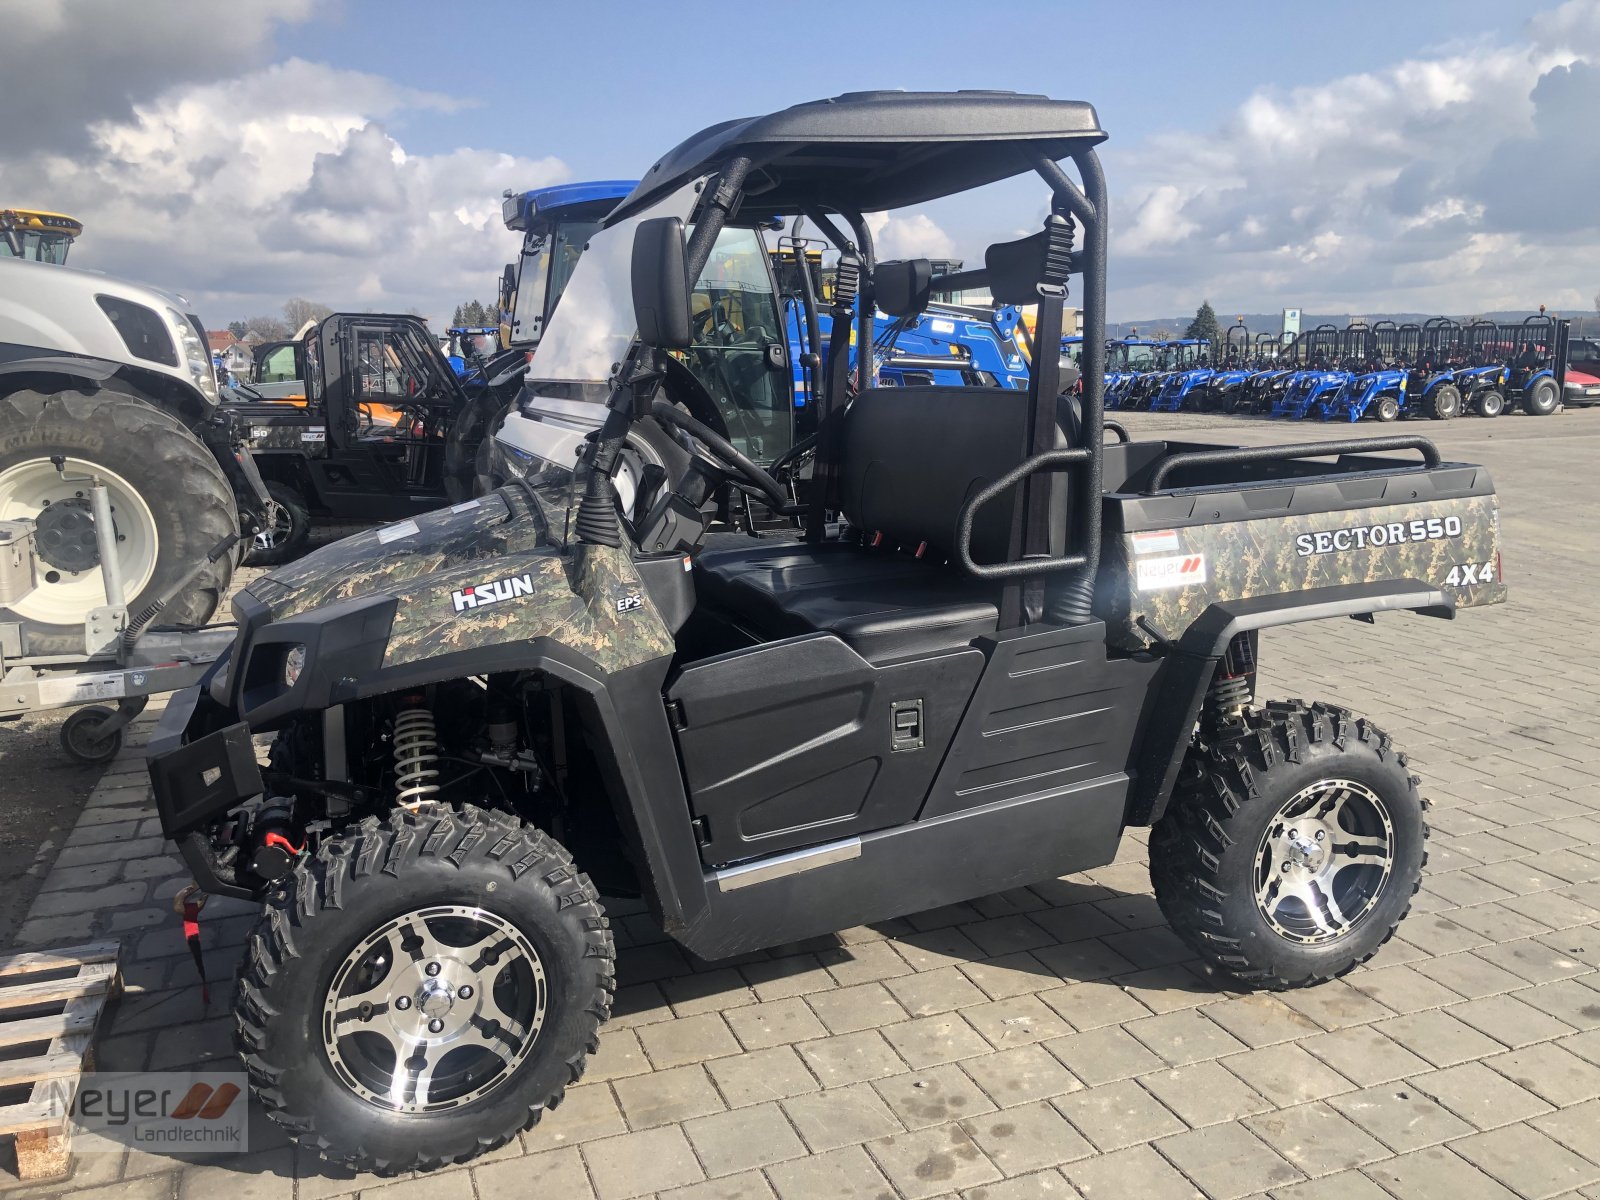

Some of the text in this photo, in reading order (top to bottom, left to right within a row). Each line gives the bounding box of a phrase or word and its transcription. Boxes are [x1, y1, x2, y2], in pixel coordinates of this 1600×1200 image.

[1296, 516, 1461, 556] SECTOR 550
[1446, 562, 1493, 587] 4X4
[452, 574, 534, 611] HSUN
[617, 594, 641, 611] EPS
